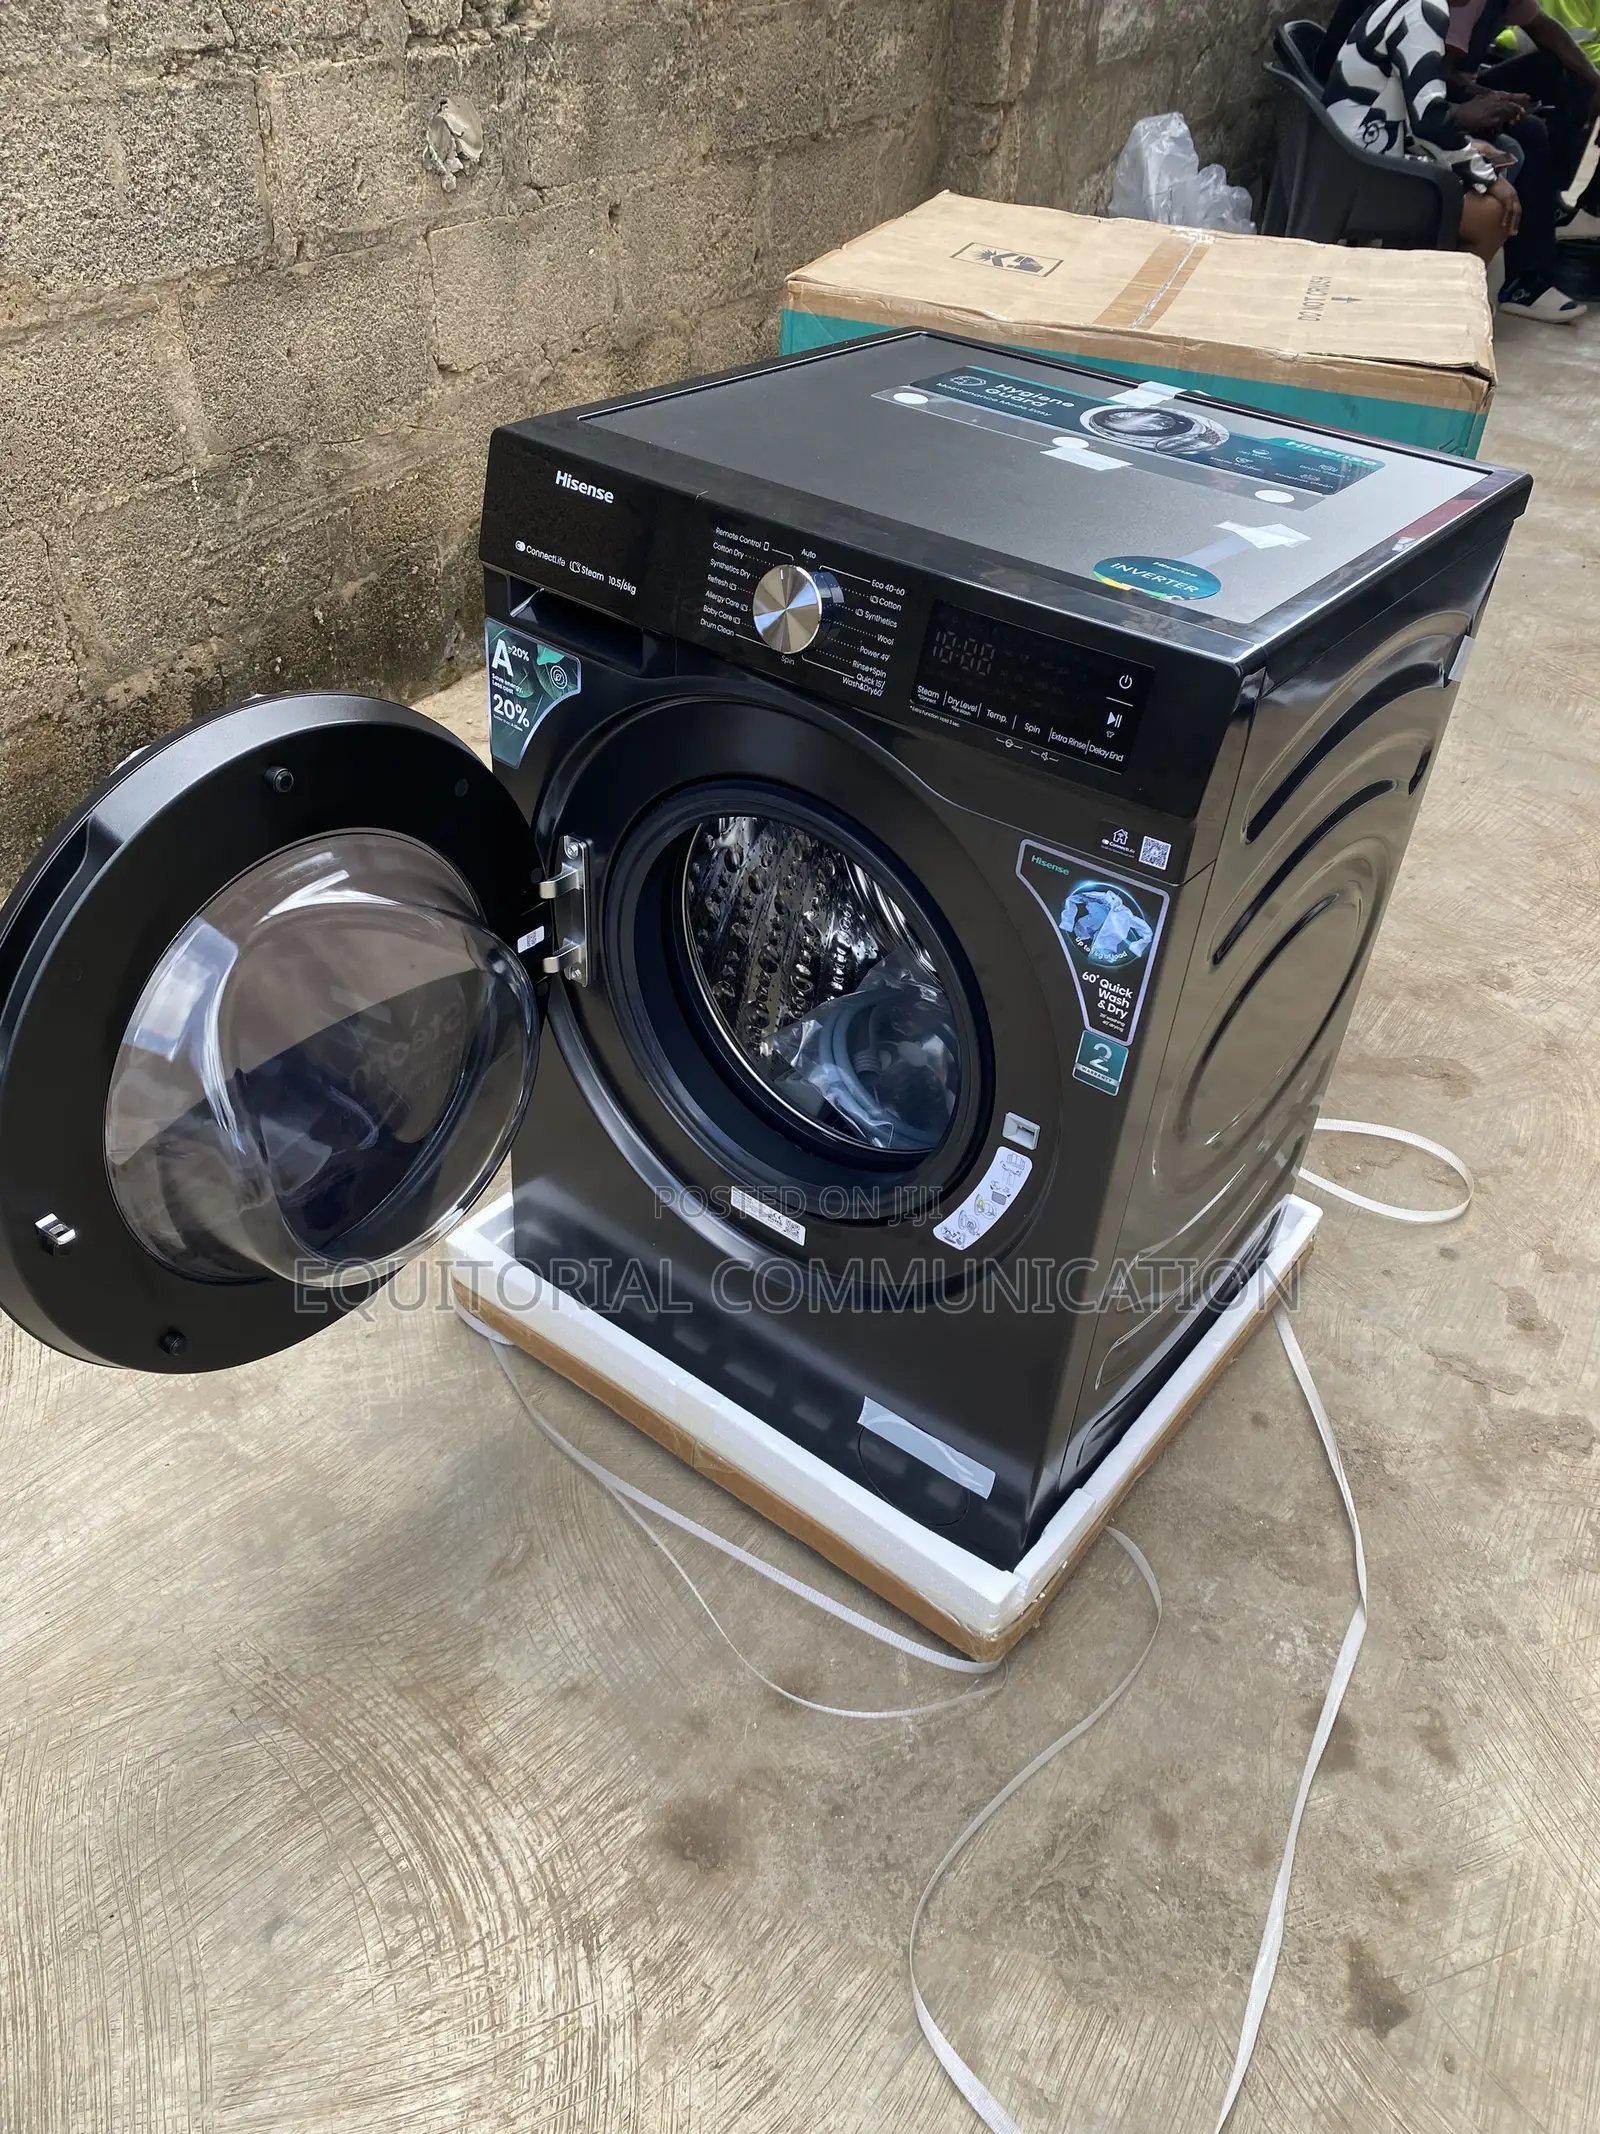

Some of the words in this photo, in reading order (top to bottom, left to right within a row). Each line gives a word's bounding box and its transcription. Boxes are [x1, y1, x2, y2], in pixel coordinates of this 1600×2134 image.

[1301, 296, 1326, 311] NOT
[1297, 311, 1322, 321] DO
[985, 388, 1048, 407] Guard
[996, 383, 1075, 408] Hygiene
[1286, 440, 1378, 466] Hisense
[555, 470, 614, 504] Hisense
[715, 526, 739, 541] Remote
[739, 534, 762, 548] Control
[712, 542, 734, 555] Cotton
[734, 548, 745, 560] Dry
[801, 548, 817, 560] Auto
[710, 558, 740, 574] Synthetics
[740, 566, 751, 580] Dry
[1110, 562, 1200, 593] INVERTER
[581, 565, 604, 582] Steam
[608, 575, 637, 596] 10.5/6kg
[707, 574, 728, 588] Refresh
[871, 579, 884, 590] Eco
[884, 582, 906, 597] 40-60
[705, 590, 725, 604] Allergy
[725, 597, 740, 609] Care
[878, 598, 902, 612] Cotton
[702, 604, 718, 618] Baby
[718, 610, 733, 622] Care
[864, 611, 898, 629] Synthetics
[700, 618, 717, 630] Drum
[717, 624, 735, 637] Clean
[877, 633, 895, 646] Wool
[492, 638, 514, 678] A
[780, 654, 795, 666] Spin
[860, 645, 880, 660] Power
[852, 660, 887, 679] Rinse+Spin
[856, 672, 874, 686] Quick
[918, 685, 940, 700] Steam
[493, 693, 530, 728] 20%
[947, 696, 960, 707] Dry
[960, 700, 978, 712] Level
[986, 708, 1008, 724] Temp.
[1024, 722, 1041, 734] Spin
[1050, 731, 1068, 744] Extra
[1068, 738, 1086, 750] Rinse
[1089, 744, 1109, 759] Delay
[1109, 752, 1124, 762] End
[1031, 854, 1070, 876] Hisense
[1076, 936, 1084, 946] Up
[1084, 944, 1090, 952] to
[1098, 987, 1130, 1008] Wash
[1100, 978, 1134, 999] Quick
[1098, 1000, 1106, 1010] &
[1107, 1004, 1128, 1020] Dry
[1089, 1042, 1112, 1073] 2
[1081, 1066, 1113, 1083] WARRANTY
